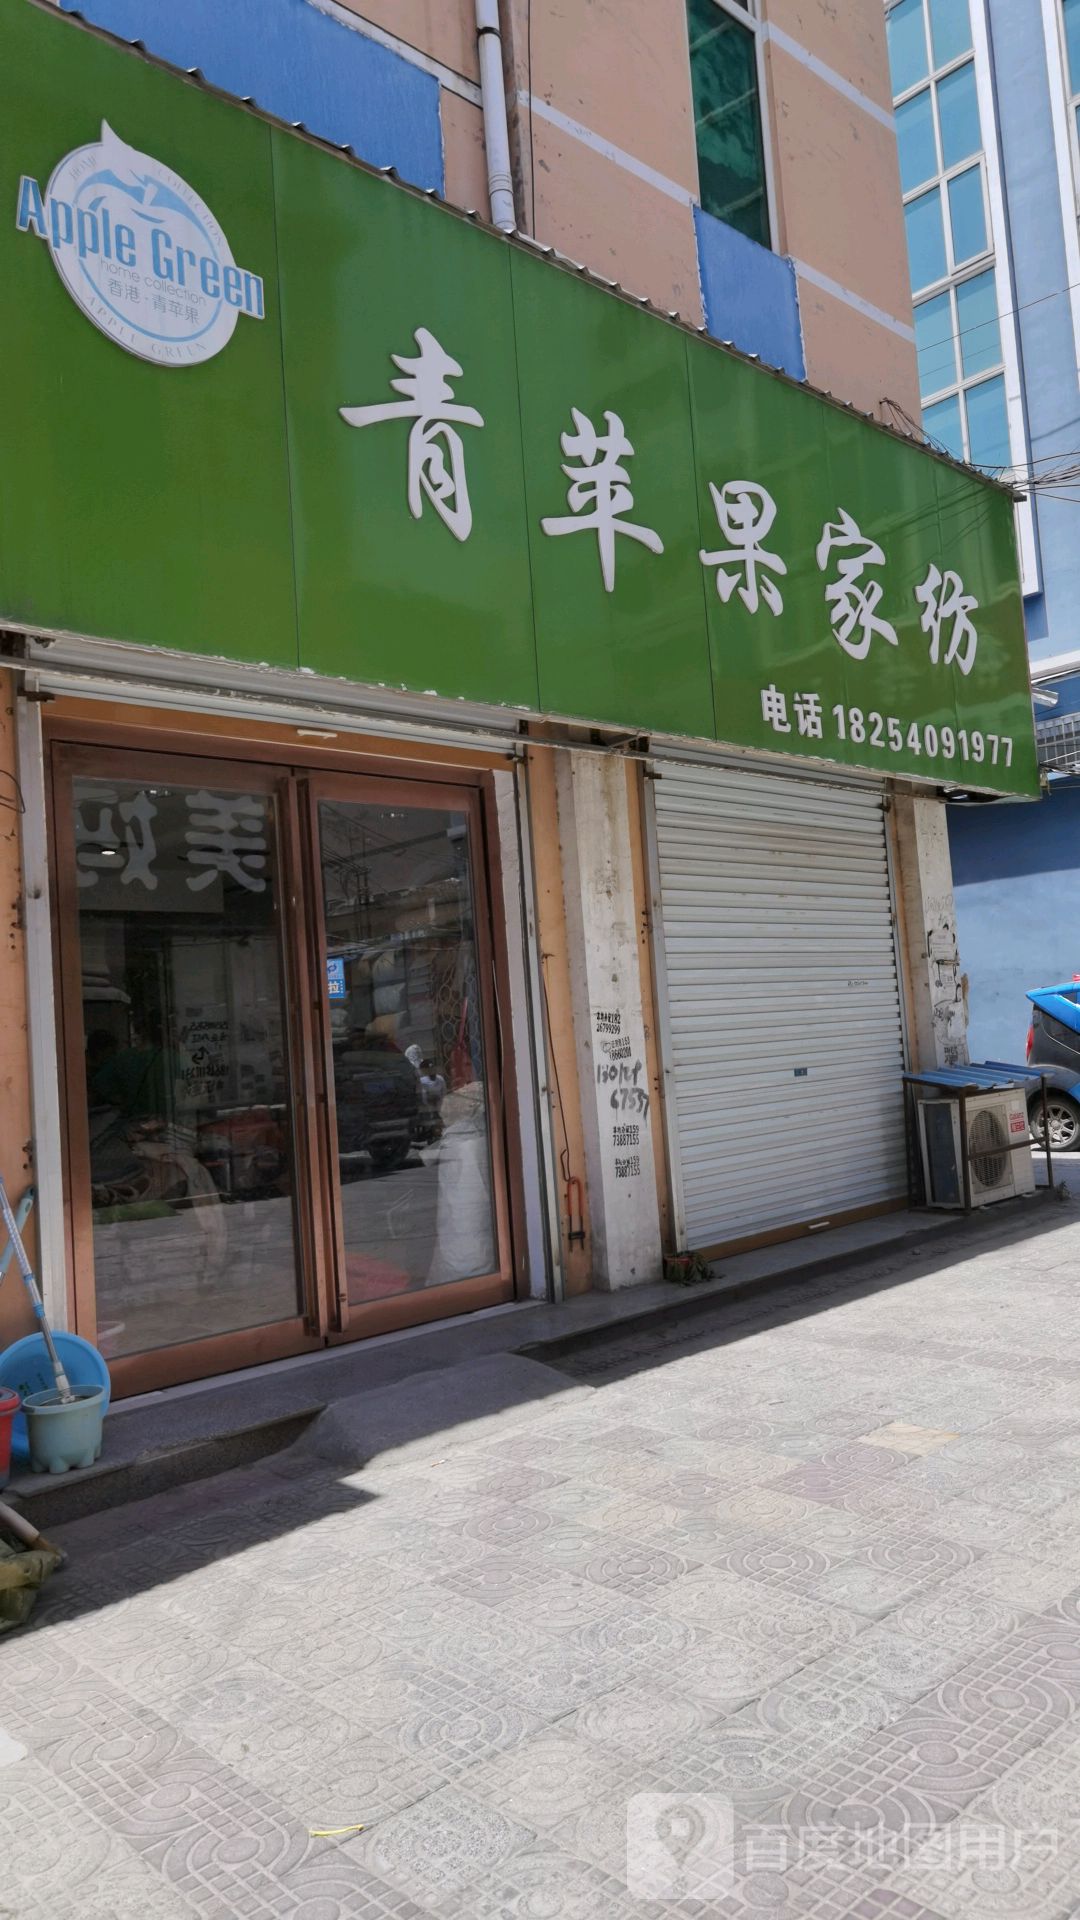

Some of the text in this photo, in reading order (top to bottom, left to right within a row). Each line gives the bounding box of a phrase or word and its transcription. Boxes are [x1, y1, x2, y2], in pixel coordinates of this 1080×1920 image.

[19, 178, 263, 318] Apple Green
[100, 257, 207, 308] home collection
[87, 294, 208, 360] APPLE GREEN
[339, 326, 979, 676] 青苹果家纺
[760, 684, 1013, 768] 电话 18254091977
